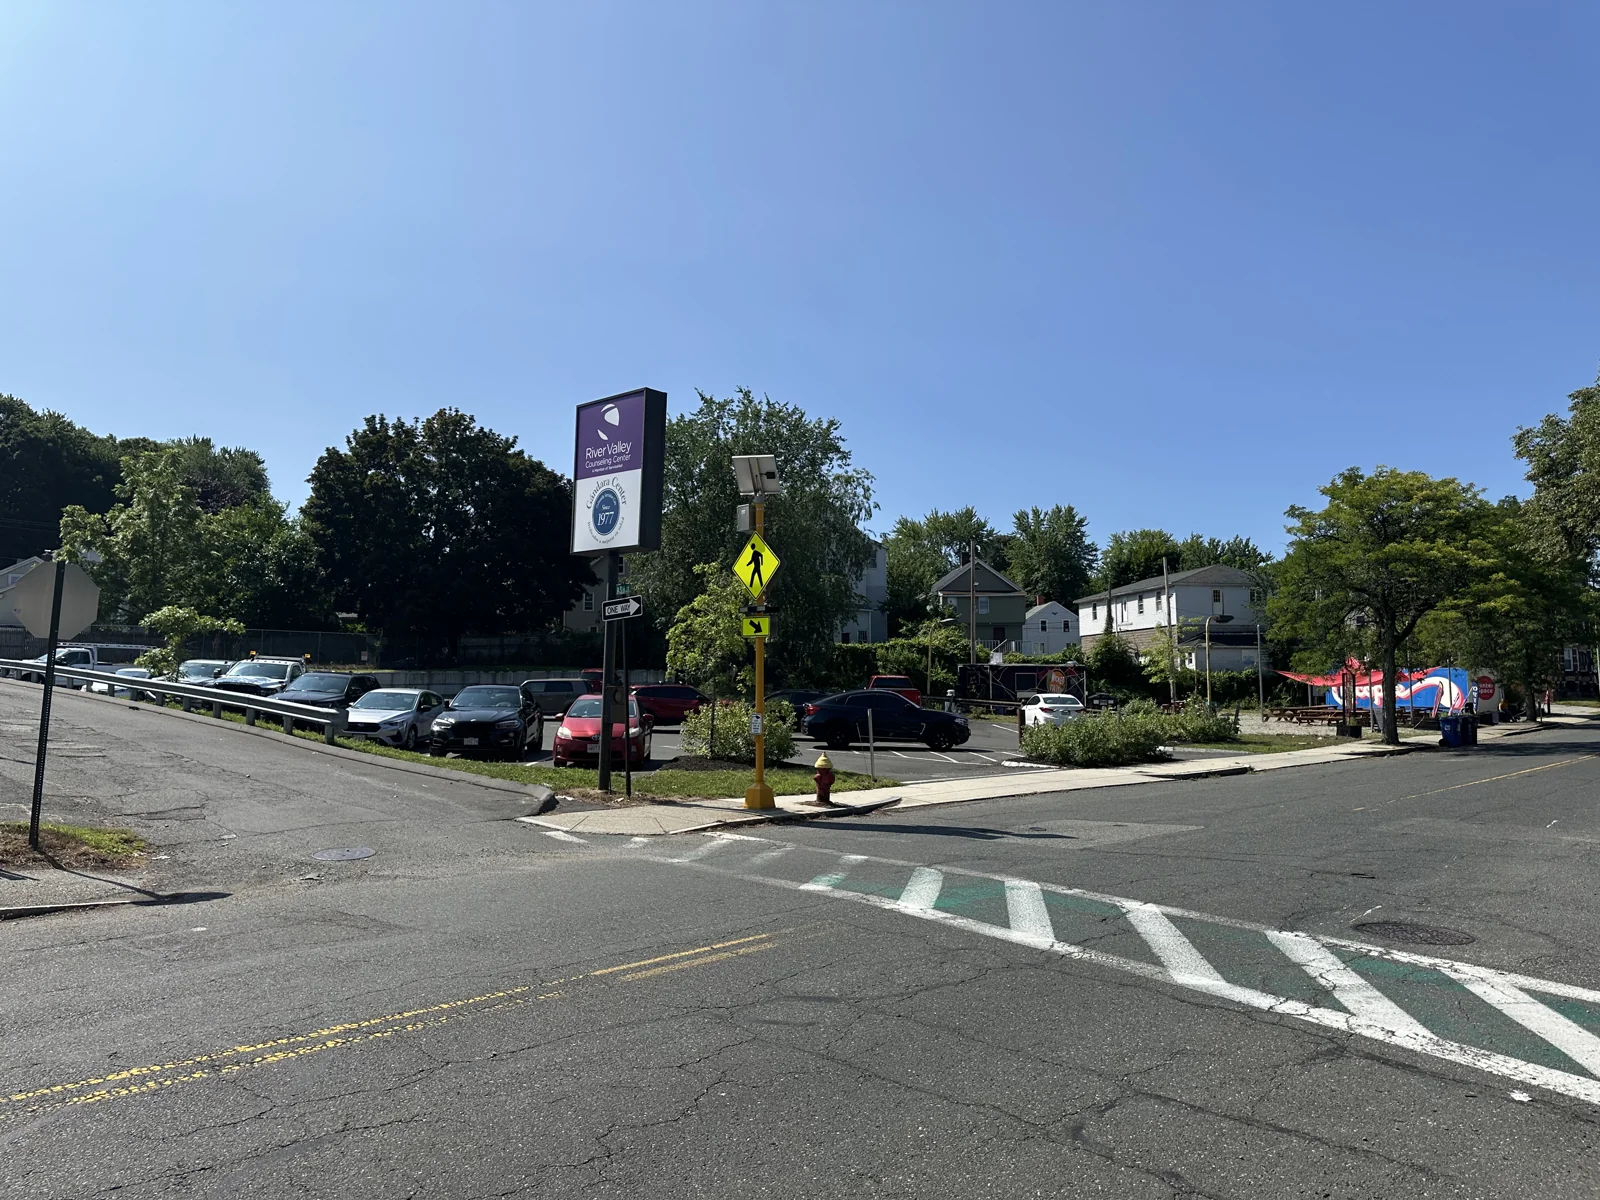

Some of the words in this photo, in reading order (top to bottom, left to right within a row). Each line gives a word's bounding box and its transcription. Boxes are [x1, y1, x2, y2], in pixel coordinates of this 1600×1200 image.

[585, 446, 606, 459] River
[606, 440, 632, 454] Valley
[585, 457, 612, 469] Counseling
[612, 454, 631, 463] Center
[611, 476, 626, 505] Center
[597, 511, 615, 526] 1977
[607, 605, 618, 614] ONE
[620, 603, 631, 612] WAY
